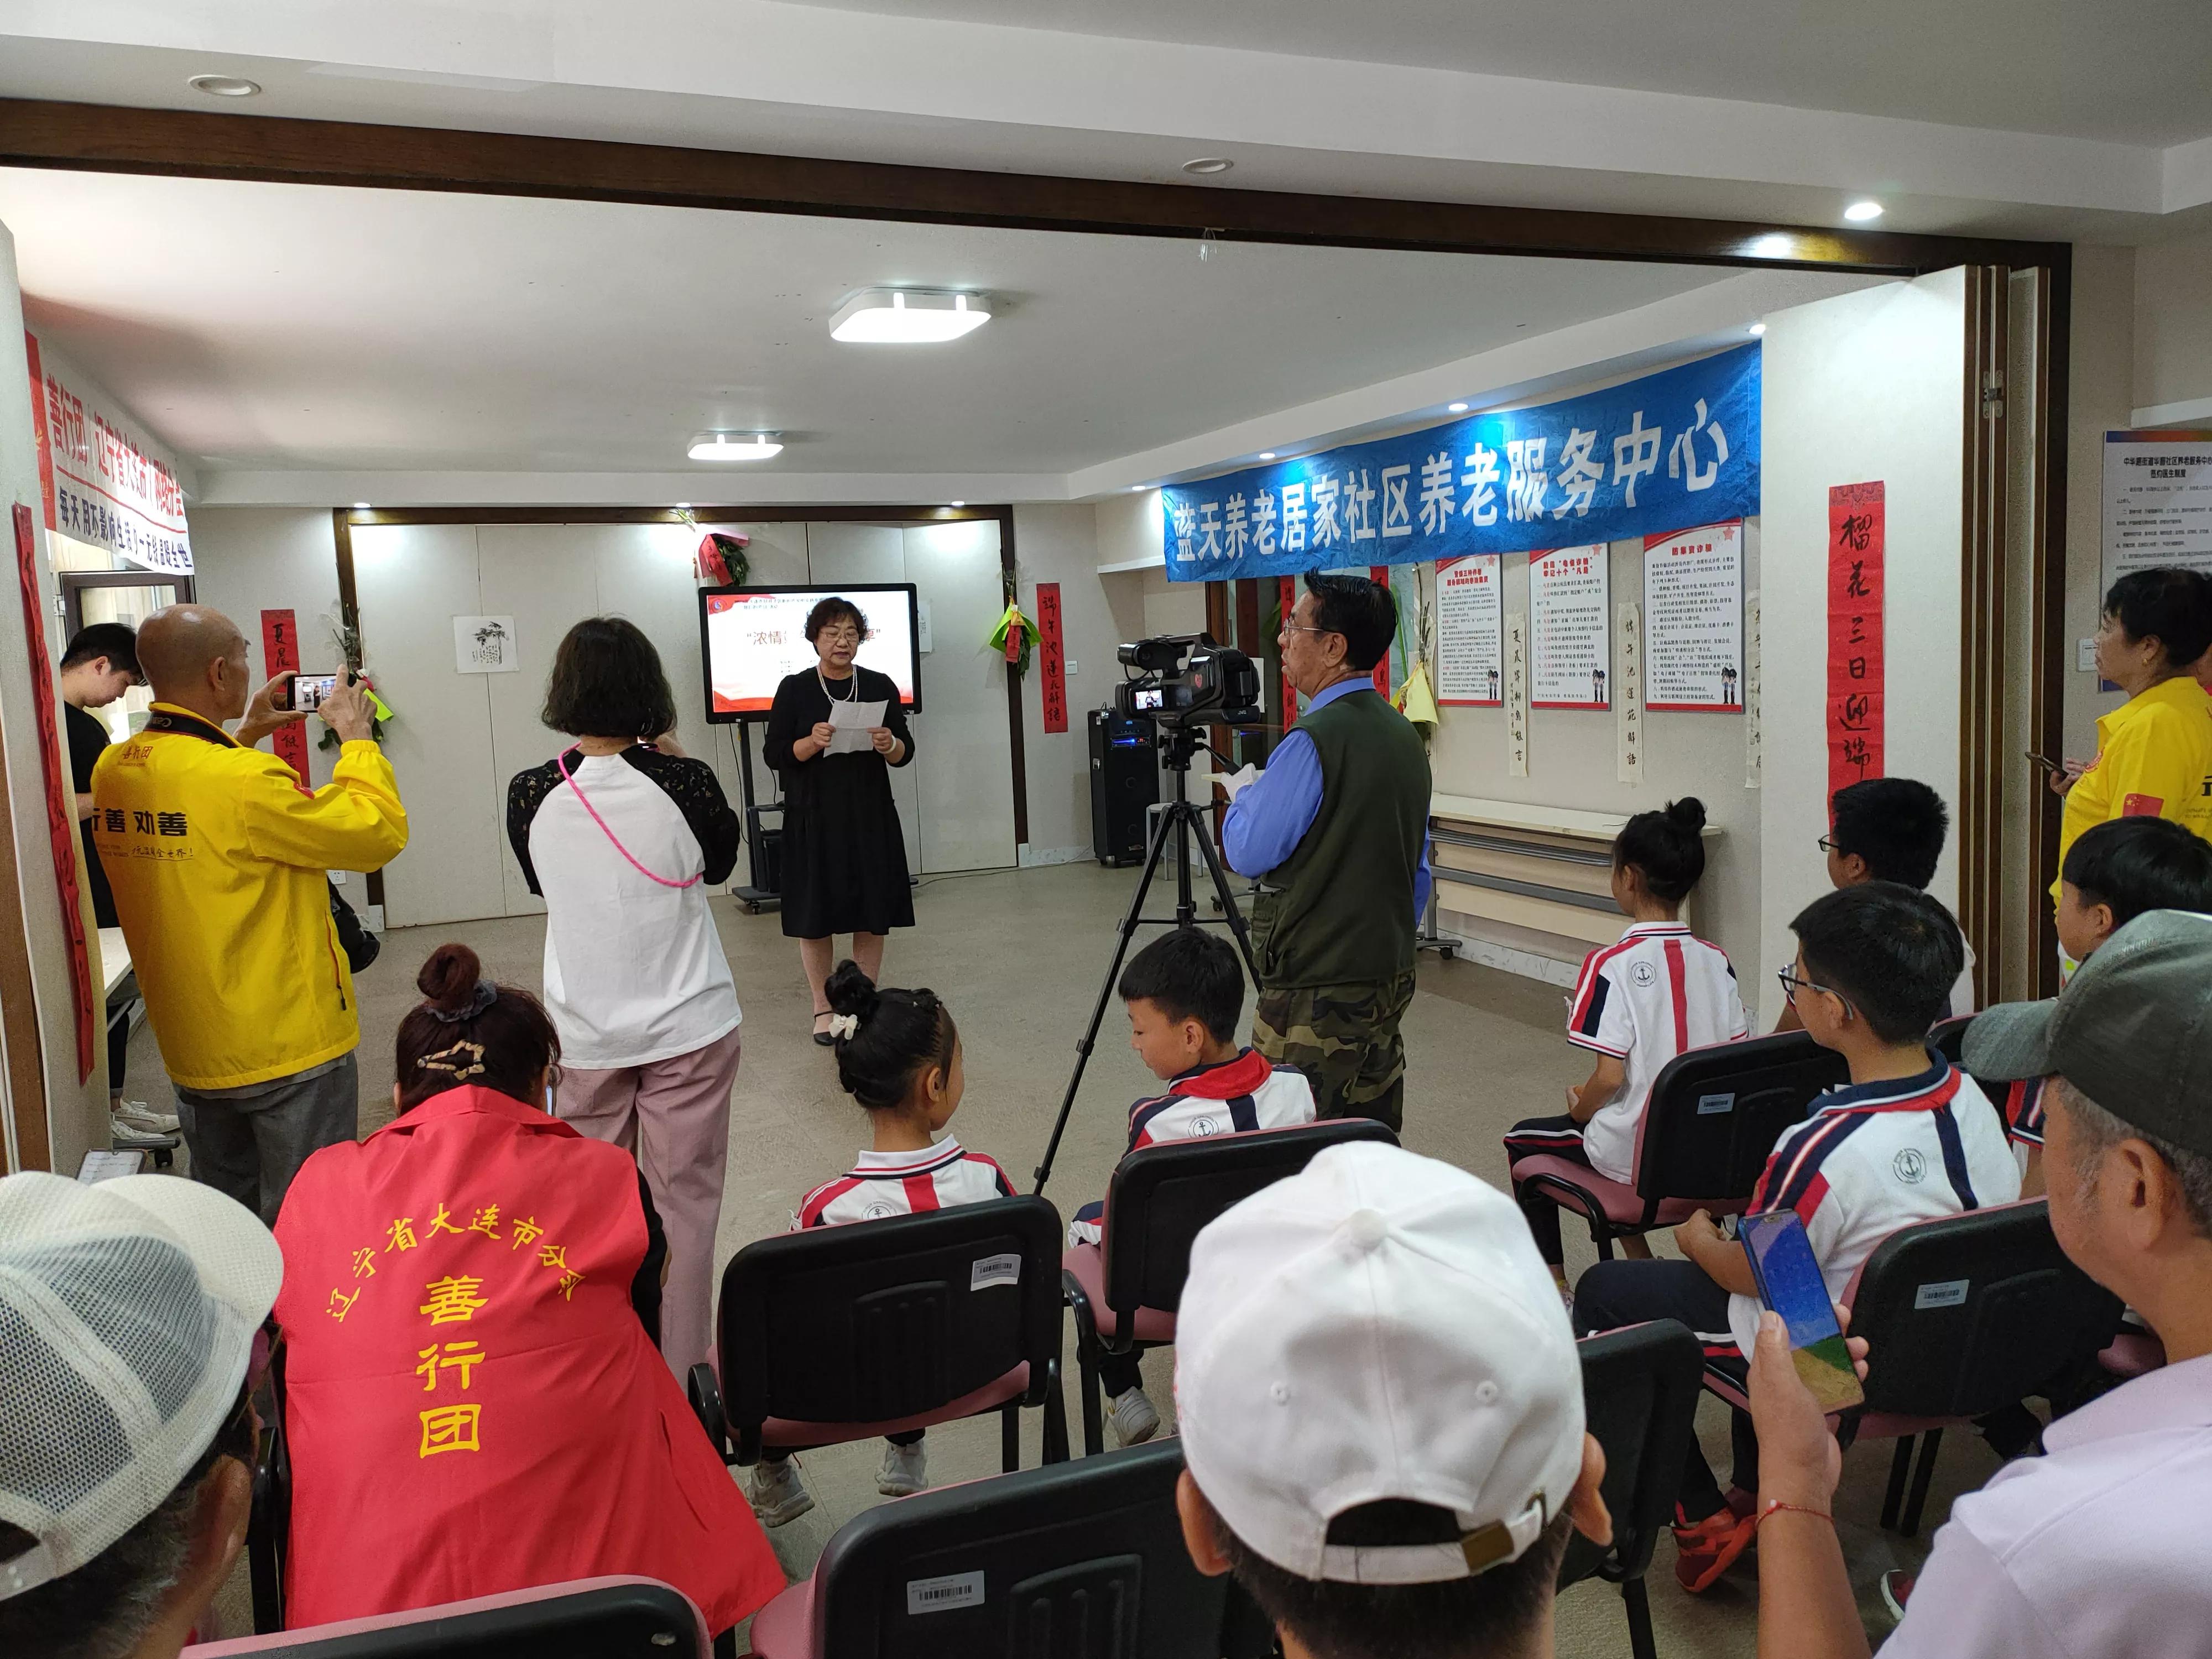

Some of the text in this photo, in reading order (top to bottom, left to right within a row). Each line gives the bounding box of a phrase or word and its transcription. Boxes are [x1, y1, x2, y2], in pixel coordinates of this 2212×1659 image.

[1174, 398, 1729, 563] 蓝天养老居家社区养老服务中心
[325, 1203, 586, 1323] 辽宁省大连市分会
[416, 1275, 489, 1459] 善行团
